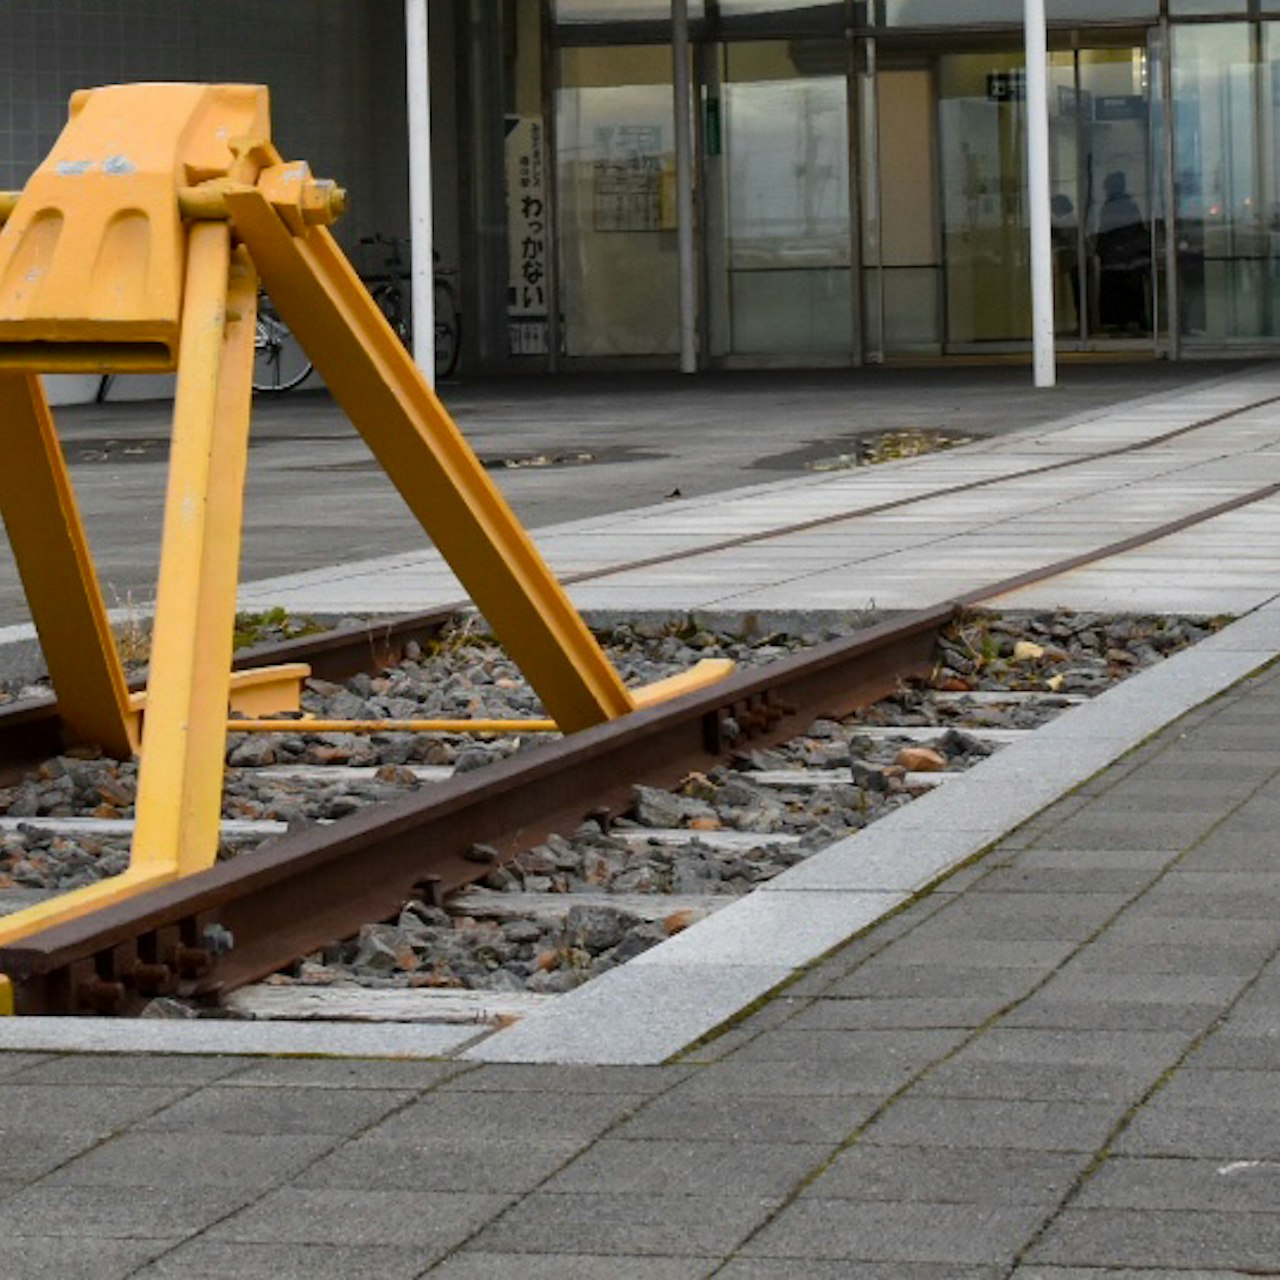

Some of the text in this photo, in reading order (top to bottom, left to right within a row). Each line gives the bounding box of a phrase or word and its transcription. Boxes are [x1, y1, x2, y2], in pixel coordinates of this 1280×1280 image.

[521, 196, 543, 308] わっかない
